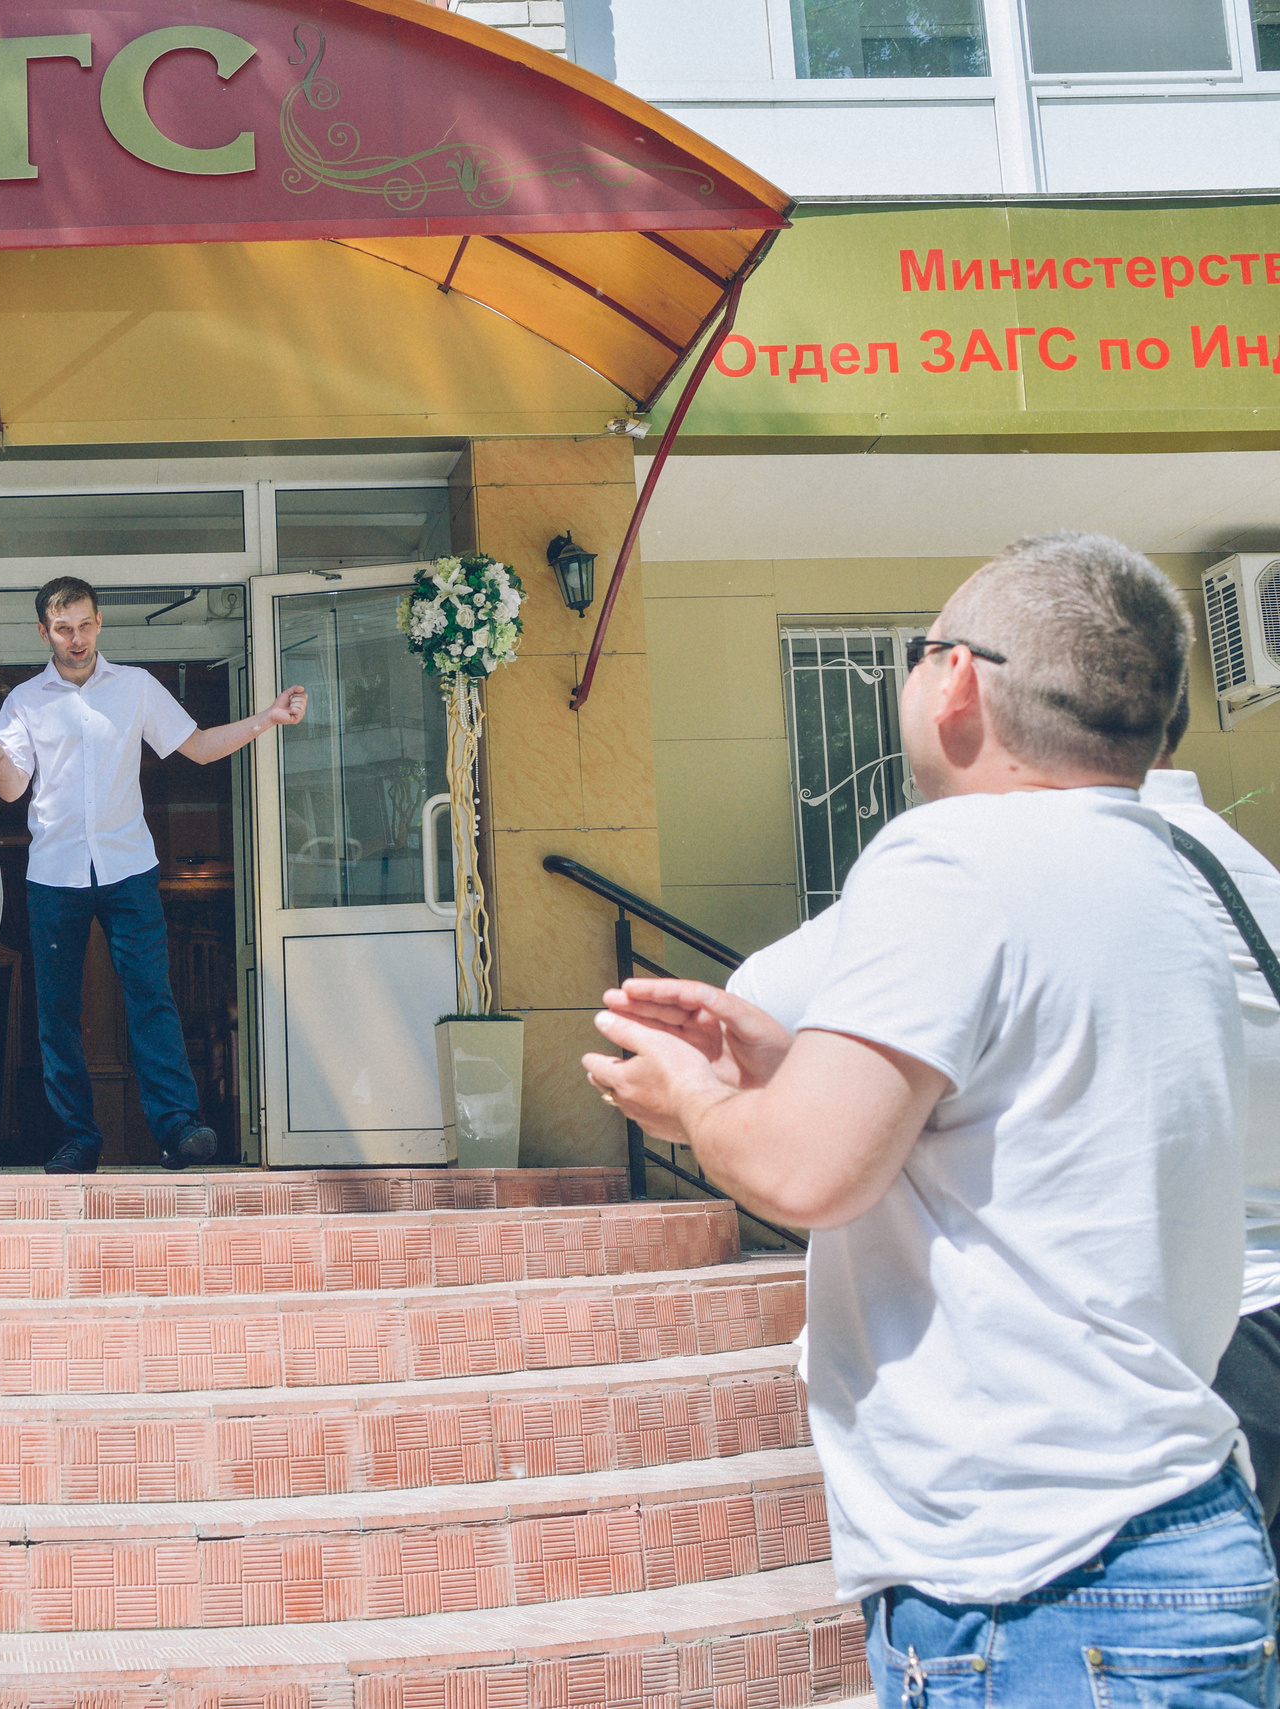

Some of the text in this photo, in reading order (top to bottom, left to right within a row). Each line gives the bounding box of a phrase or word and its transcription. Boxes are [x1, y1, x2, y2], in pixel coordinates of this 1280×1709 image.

[714, 324, 1280, 384] Отдел ЗАГС по Ин
